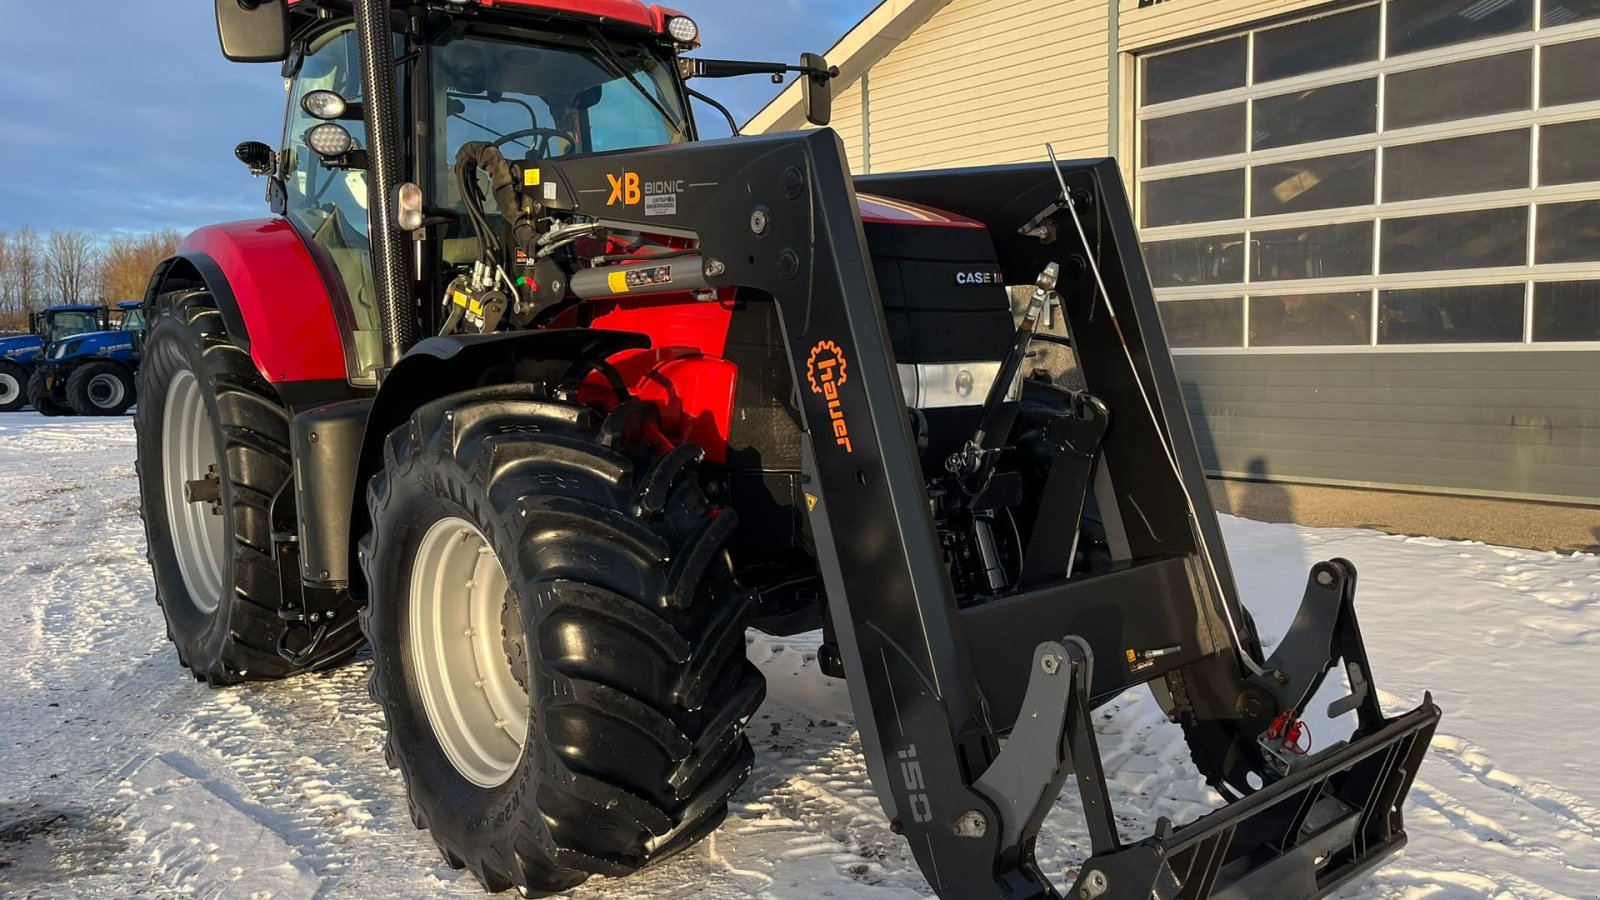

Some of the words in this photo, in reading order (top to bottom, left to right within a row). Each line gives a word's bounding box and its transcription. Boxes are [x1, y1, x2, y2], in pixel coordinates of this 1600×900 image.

[606, 172, 641, 206] XB
[644, 180, 684, 195] BIONIC
[956, 272, 991, 284] CASE
[817, 358, 852, 453] hauer
[897, 744, 933, 823] 150
